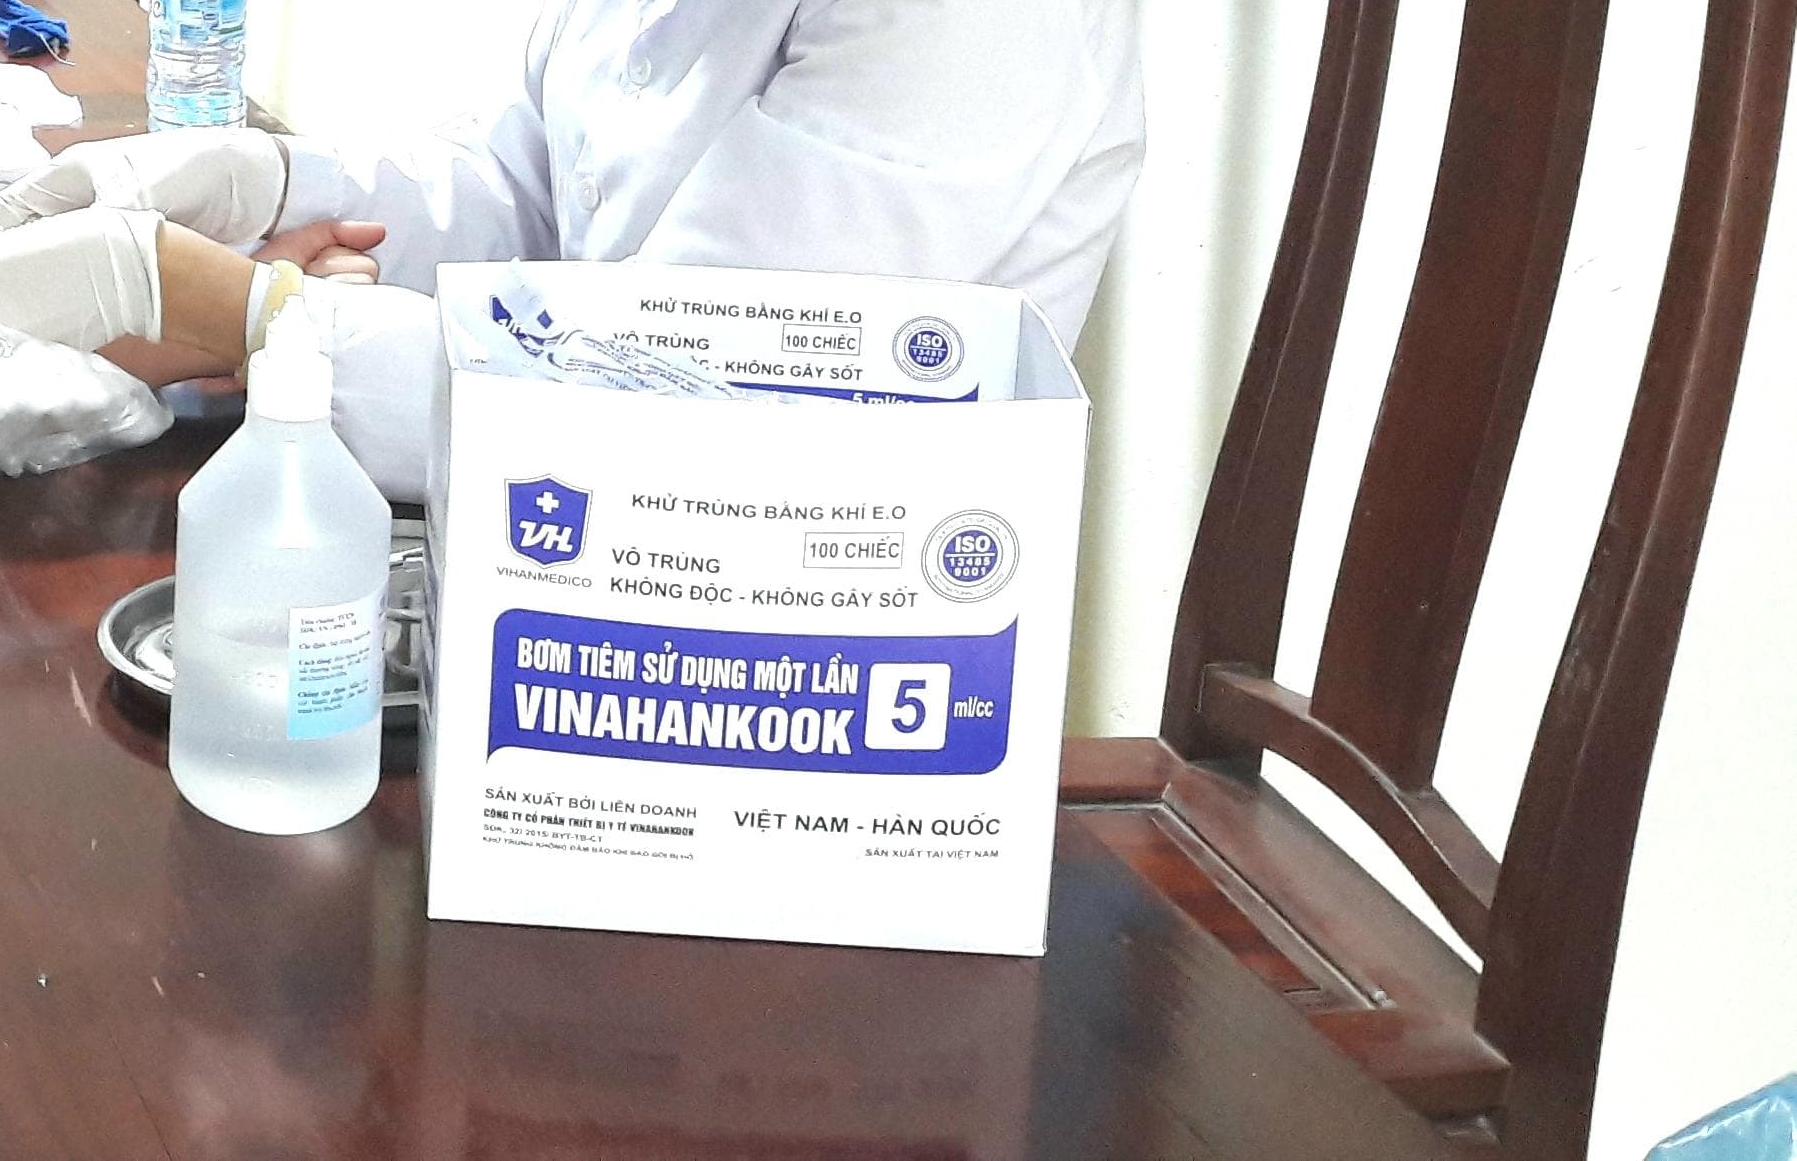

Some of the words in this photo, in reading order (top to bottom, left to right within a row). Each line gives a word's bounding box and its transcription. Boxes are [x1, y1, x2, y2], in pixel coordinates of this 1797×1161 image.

[640, 296, 678, 314] KHỬ
[681, 300, 740, 318] TRÙNG
[797, 308, 829, 326] KHÍ
[832, 310, 862, 329] E.O
[645, 332, 710, 351] TRÙNG
[785, 334, 809, 348] 100
[812, 333, 856, 351] CHIẾC
[916, 333, 944, 349] ISO
[724, 359, 785, 376] KHÔNG
[789, 362, 825, 379] GÂY
[829, 363, 864, 381] SỐT
[631, 493, 678, 512] KHỬ
[682, 498, 757, 519] TRÙNG
[831, 503, 866, 520] KHÍ
[872, 505, 906, 520] E.O
[810, 542, 839, 559] 100
[844, 535, 900, 559] CHIẾC
[954, 535, 992, 554] ISO
[611, 546, 641, 566] VÔ
[647, 551, 721, 574] TRÙNG
[496, 564, 593, 588] VIHANMEDICO
[610, 576, 683, 599] KHÔNG
[689, 582, 733, 606] ĐỘC
[751, 586, 824, 608] KHÔNG
[831, 588, 873, 608] GÂY
[879, 585, 919, 608] SỐT
[517, 637, 572, 675] BƠM
[577, 640, 636, 681] TIÊM
[641, 640, 679, 685] SỬ
[680, 656, 747, 695] DỤNG
[752, 655, 807, 700] MỘT
[811, 651, 859, 695] LẦN
[513, 683, 855, 755] VINAHANKOOK
[891, 679, 927, 732] 5
[953, 696, 994, 719] ml/cc
[484, 786, 517, 802] SẢN
[600, 799, 635, 814] LIÊN
[640, 804, 697, 819] DOANH
[733, 808, 788, 833] VIỆT
[794, 814, 849, 834] NAM
[872, 813, 923, 836] HÀN
[930, 812, 1001, 837] QUỐC
